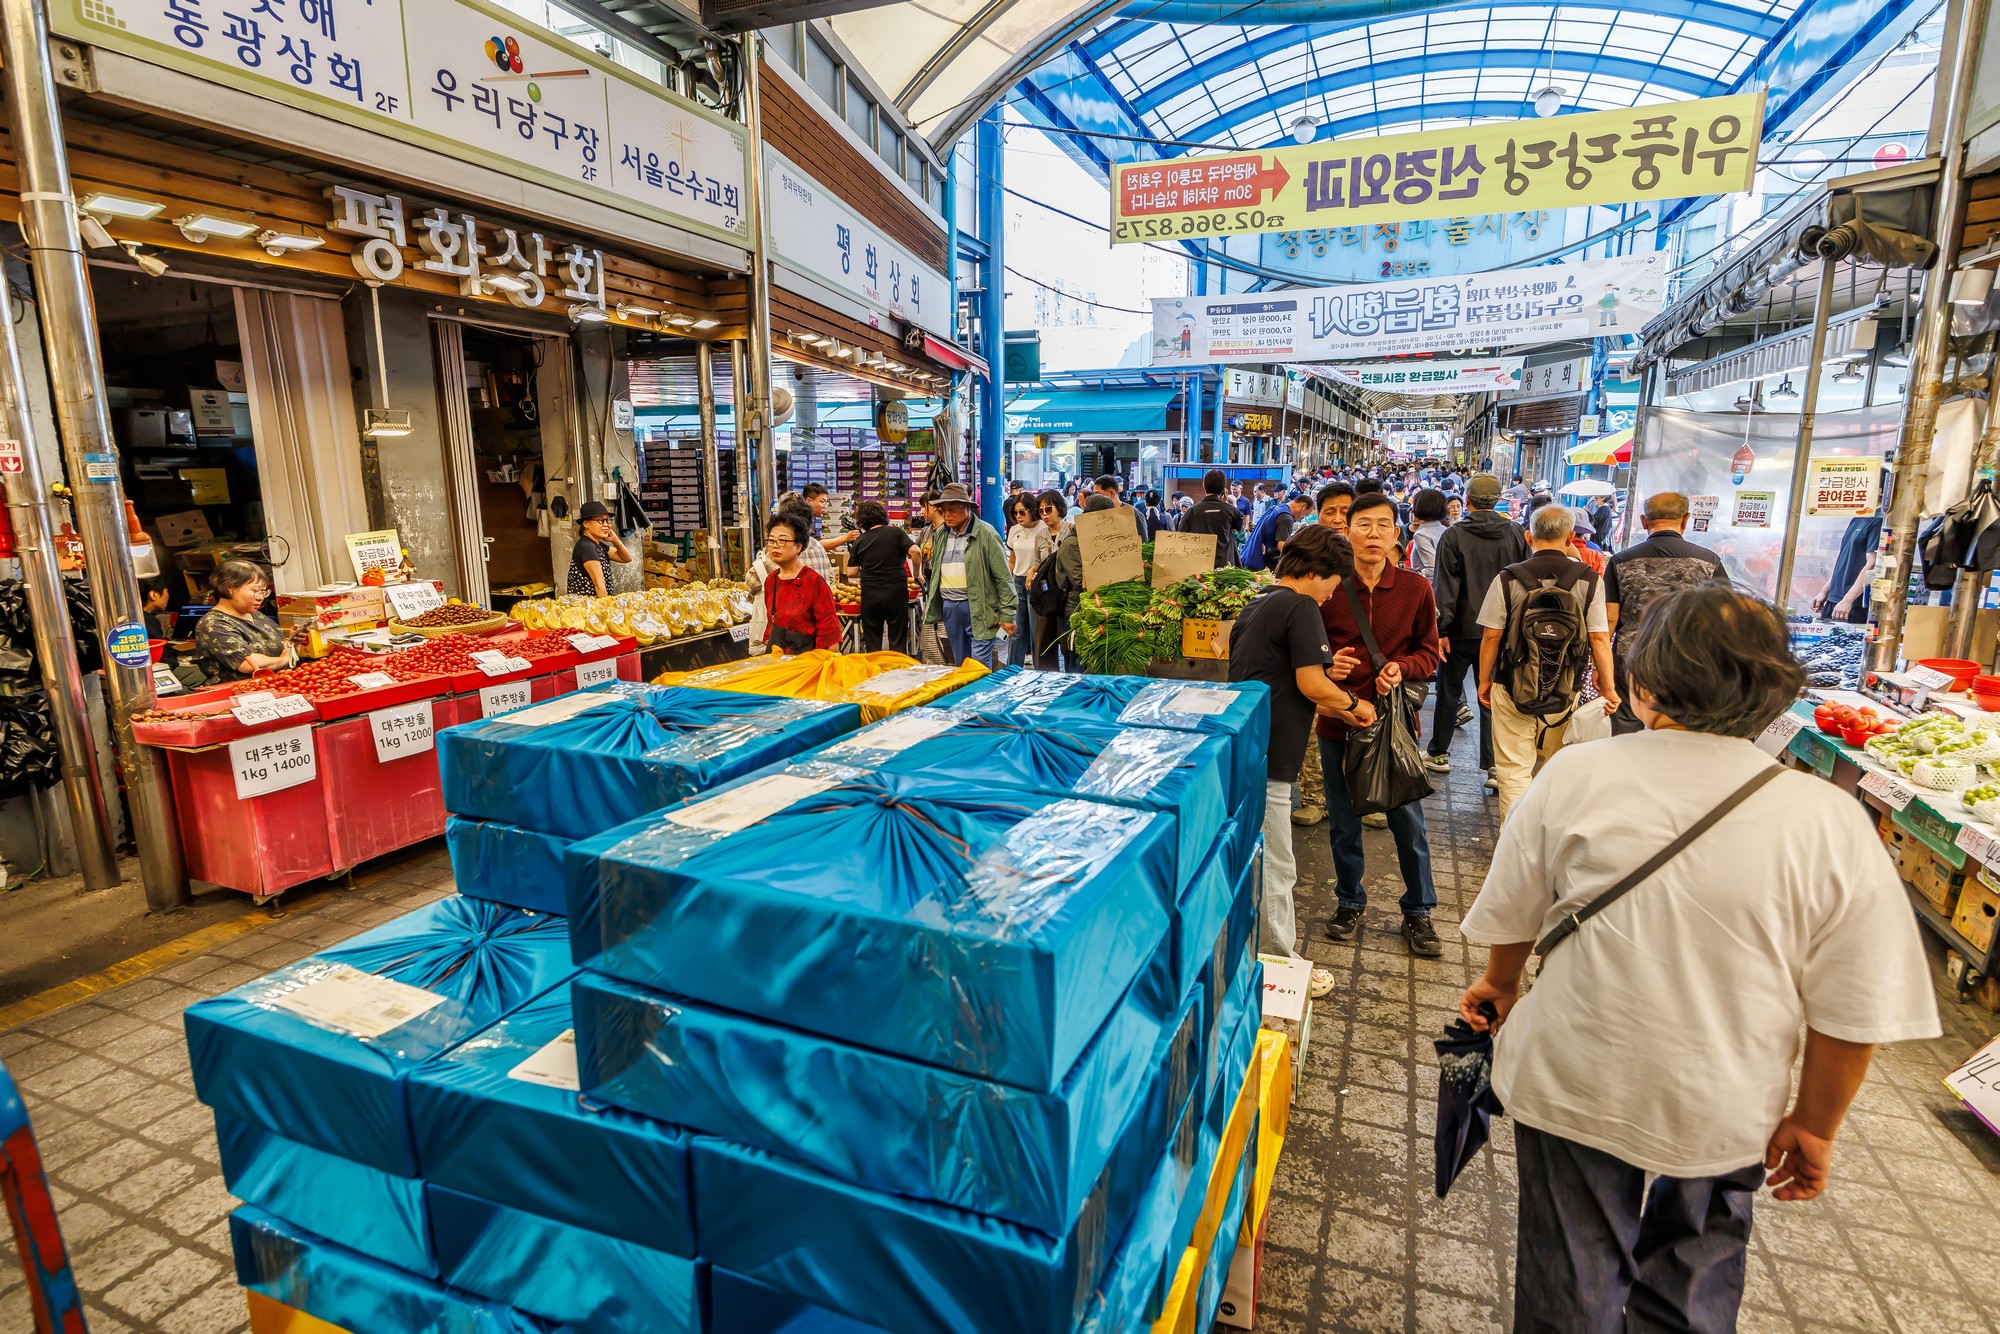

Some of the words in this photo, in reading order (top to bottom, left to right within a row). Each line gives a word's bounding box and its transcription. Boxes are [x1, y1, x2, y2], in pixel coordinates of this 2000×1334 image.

[163, 0, 364, 103] 동광상회
[375, 91, 398, 114] 2F
[431, 68, 599, 163] 우리당구장
[581, 165, 598, 181] 2F
[620, 143, 740, 216] 서울은수교회
[724, 216, 736, 229] 2F
[323, 185, 606, 310] 평화상회
[836, 223, 920, 314] 평화상회
[1361, 372, 1406, 384] 전통시장
[1409, 369, 1458, 382] 환급행사
[1819, 476, 1869, 489] 환급행사
[1817, 490, 1867, 502] 참여점포
[357, 547, 395, 560] 환급행사
[397, 589, 432, 600] 대추방울
[399, 602, 416, 611] 1kg
[117, 634, 145, 644] 고유가
[583, 667, 613, 682] 대추방울
[490, 691, 526, 707] 대추방울
[381, 712, 426, 733] 대추방울
[379, 736, 401, 749] 1kg
[404, 727, 432, 743] 12000
[245, 738, 302, 763] 대추방울
[241, 768, 268, 781] 1kg
[272, 753, 311, 773] 14000
